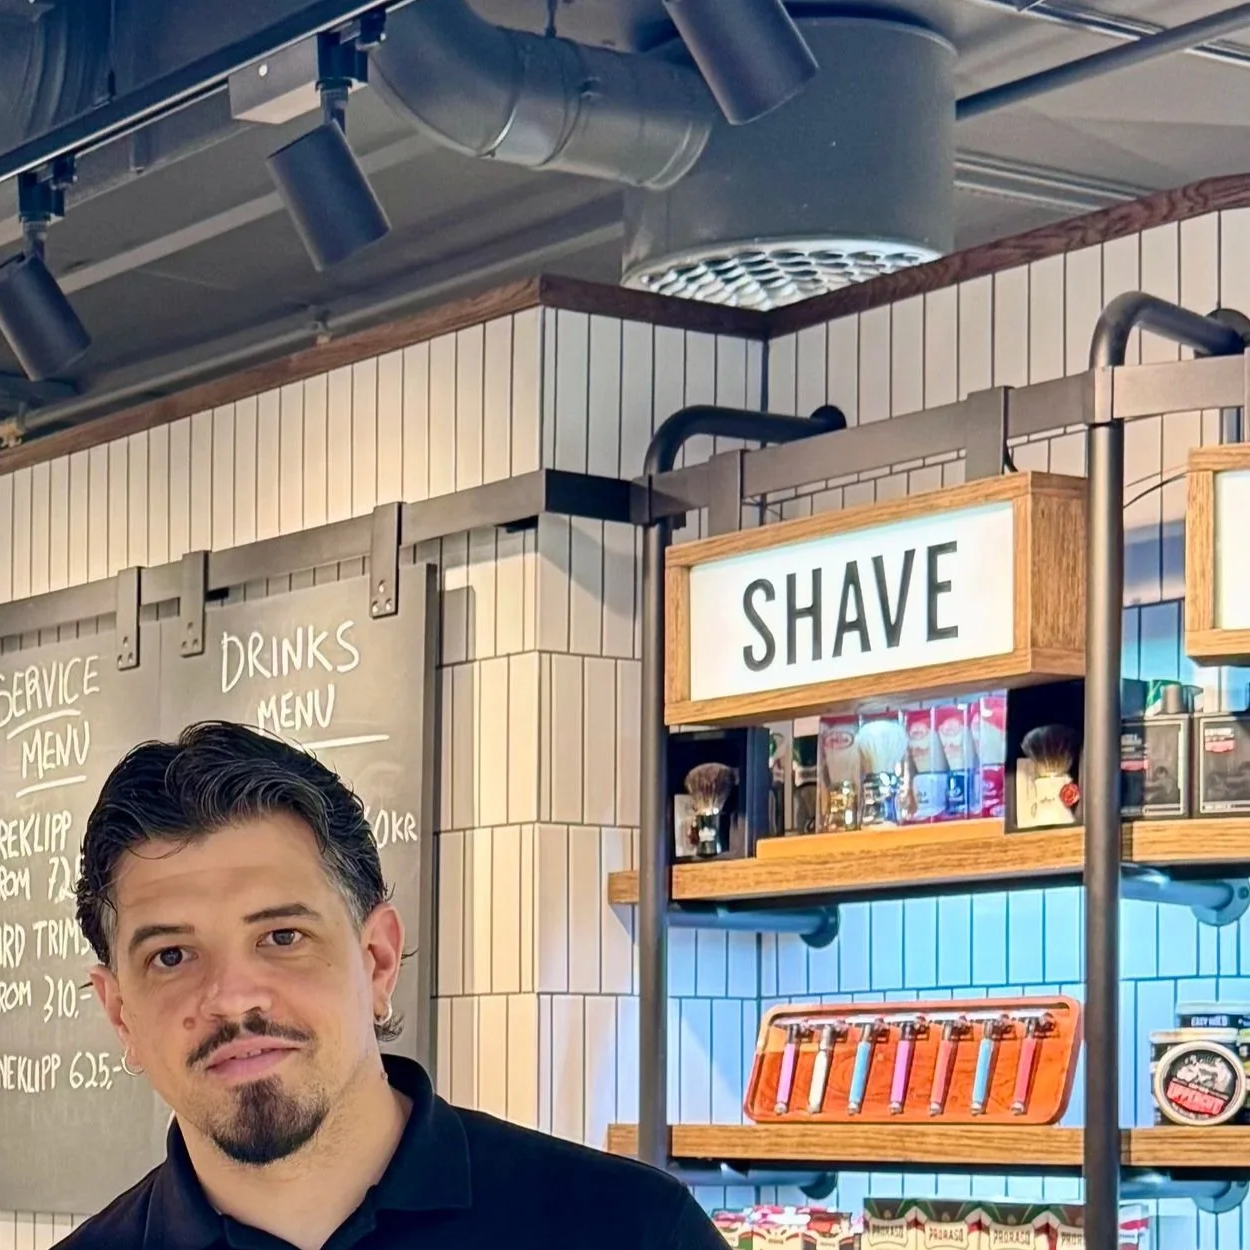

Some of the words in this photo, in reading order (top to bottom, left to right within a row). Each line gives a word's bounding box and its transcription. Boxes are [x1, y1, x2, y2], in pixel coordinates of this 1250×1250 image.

[742, 540, 959, 673] SHAVE
[221, 620, 360, 693] DRINKS
[257, 684, 335, 736] MENU
[22, 721, 90, 779] MENU
[69, 1052, 122, 1090] 625,-
[871, 1224, 904, 1240] PRORASO
[928, 1226, 964, 1243] PRORASO
[993, 1229, 1031, 1246] PRORASO
